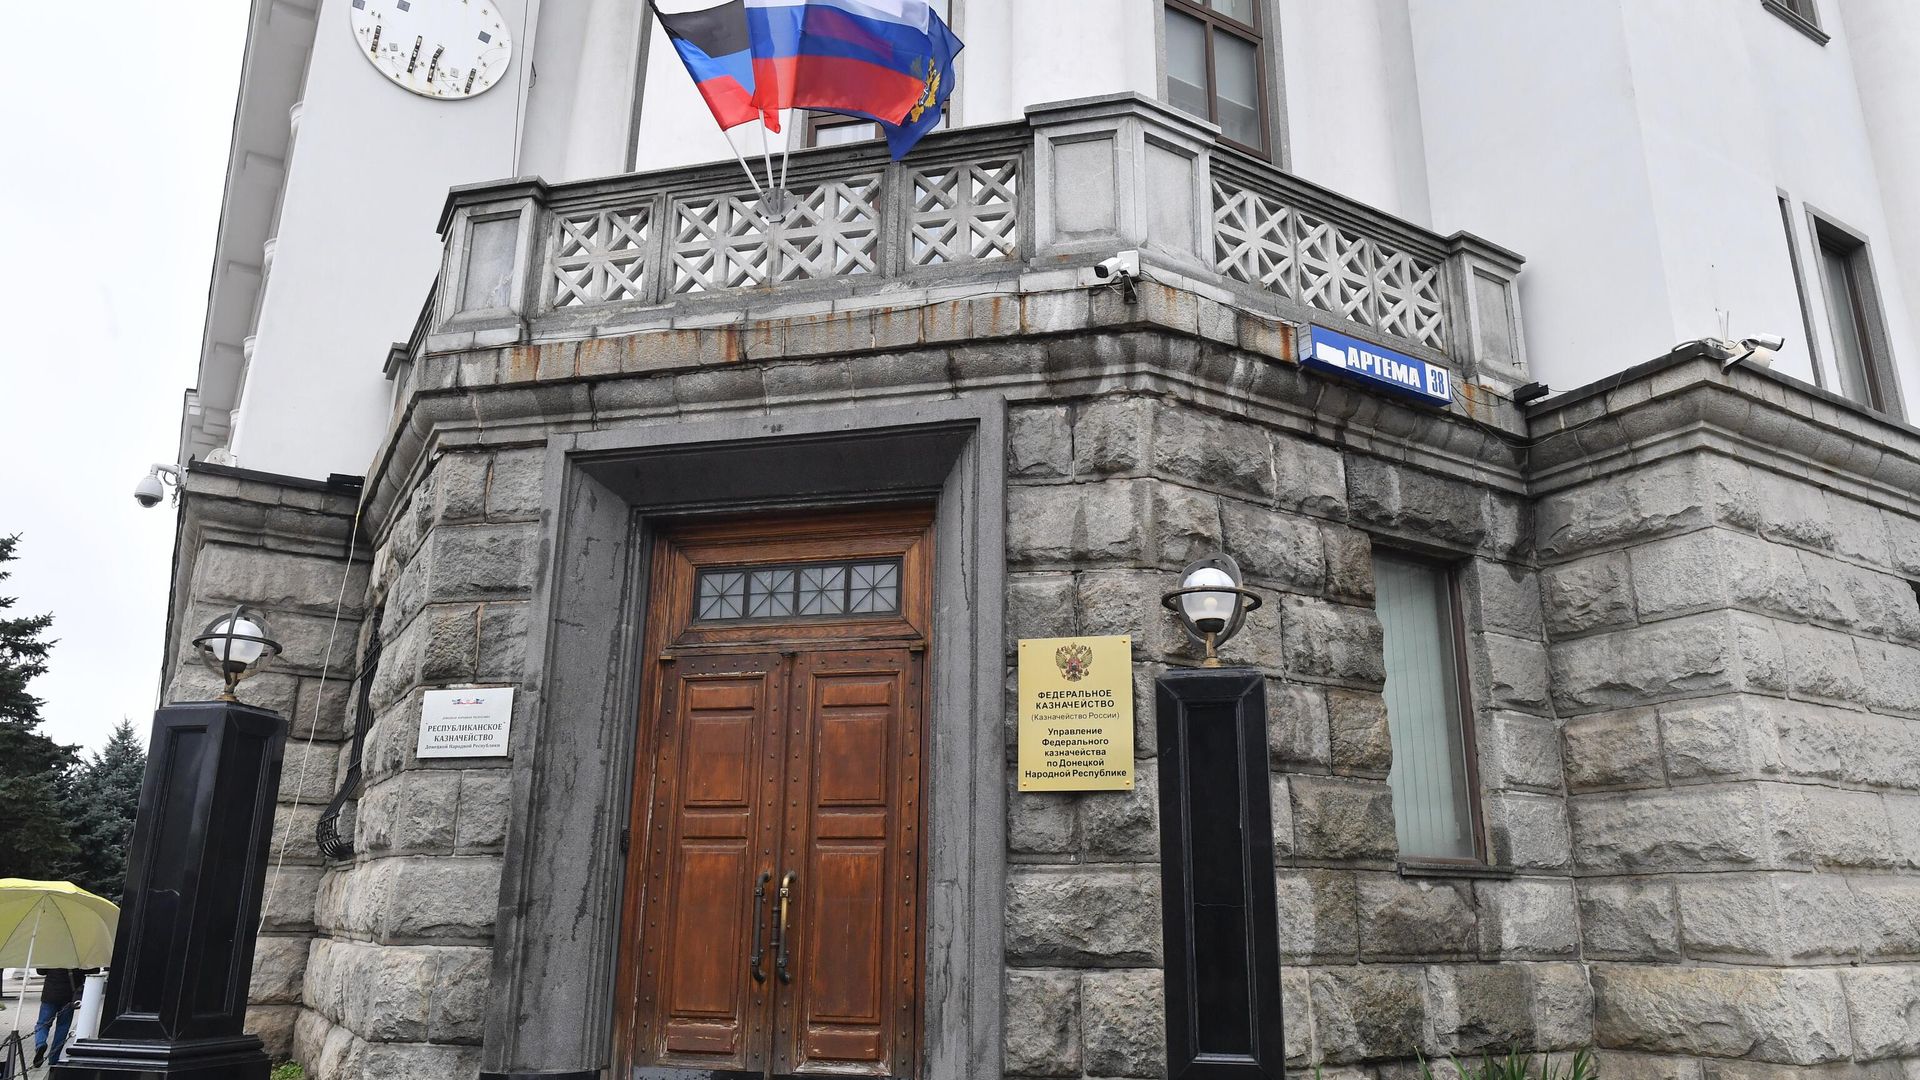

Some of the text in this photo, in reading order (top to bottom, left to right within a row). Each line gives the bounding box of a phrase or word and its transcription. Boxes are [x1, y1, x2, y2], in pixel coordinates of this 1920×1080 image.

[1347, 346, 1445, 395] АРТЕМА 38
[1038, 689, 1112, 700] ФЕДЕРАЛЬНОЕ
[1035, 699, 1115, 710] КАЗНАЧЕЙСТВО
[1031, 711, 1120, 722] (Казначейство России)
[427, 723, 503, 732] РЕСПУБЛИКАНСКОЕ
[1048, 728, 1103, 737] Управление
[434, 733, 494, 742] КАЗНАЧЕЙСТВО
[1041, 738, 1109, 747] Федерального
[1044, 748, 1107, 757] казначейства
[1046, 758, 1105, 768] по Донецкой
[1025, 769, 1127, 779] Народной Республике
